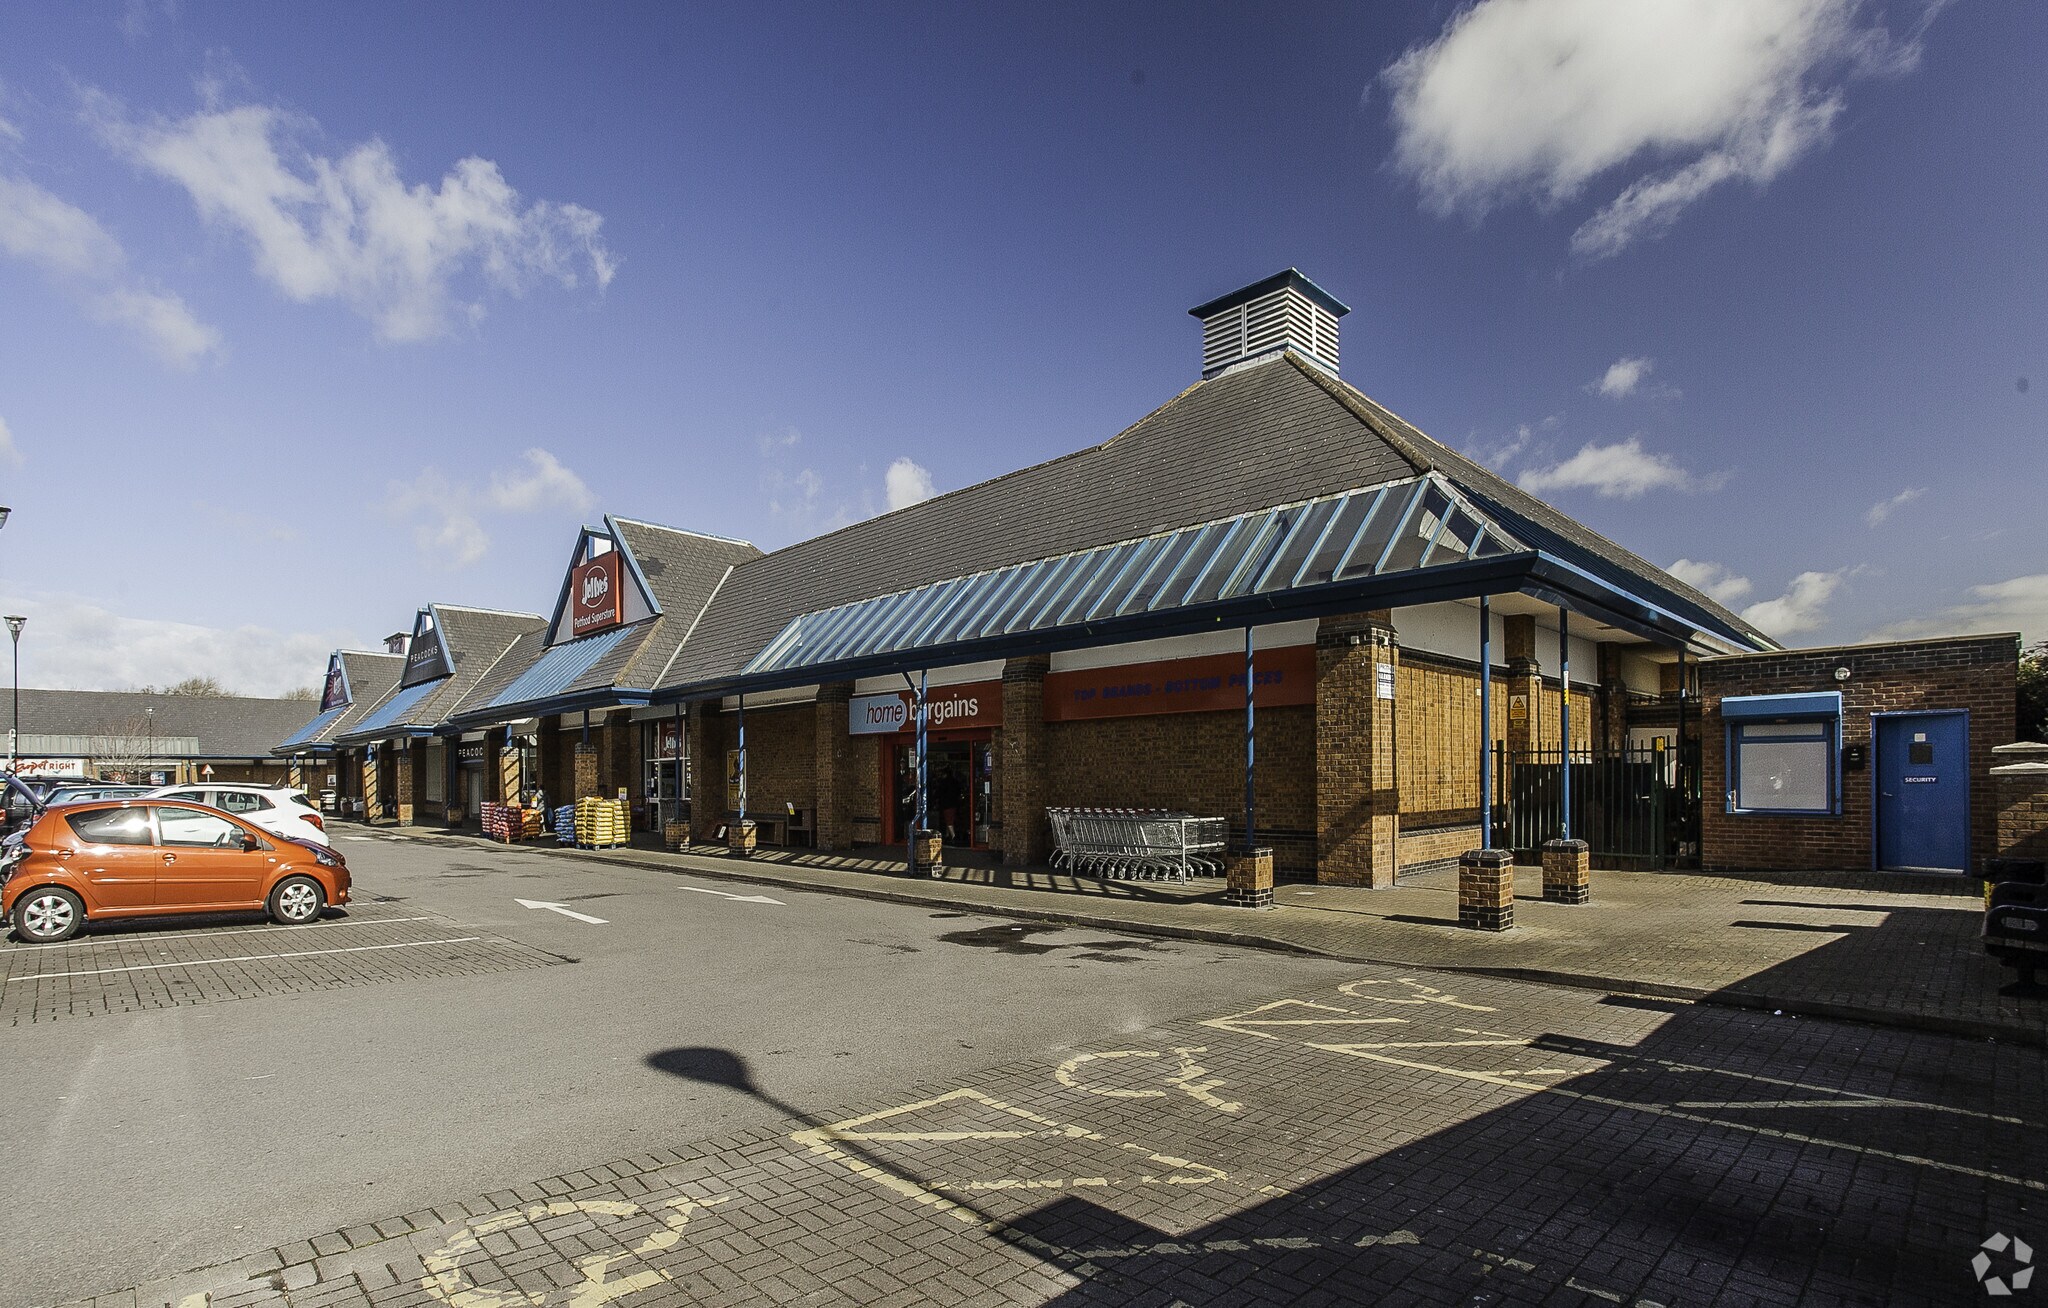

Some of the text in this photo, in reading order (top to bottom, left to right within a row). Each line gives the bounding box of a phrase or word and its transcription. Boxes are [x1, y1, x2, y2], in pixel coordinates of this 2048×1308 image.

[574, 608, 615, 629] Petfood Superstore
[410, 645, 438, 662] PEACOCKS
[1073, 688, 1096, 701] TOP
[1102, 683, 1153, 699] BRANDS
[1164, 676, 1222, 694] BOTTOM
[1228, 670, 1284, 688] PRCES
[866, 693, 978, 725] home brgains
[458, 747, 484, 757] PEACOC
